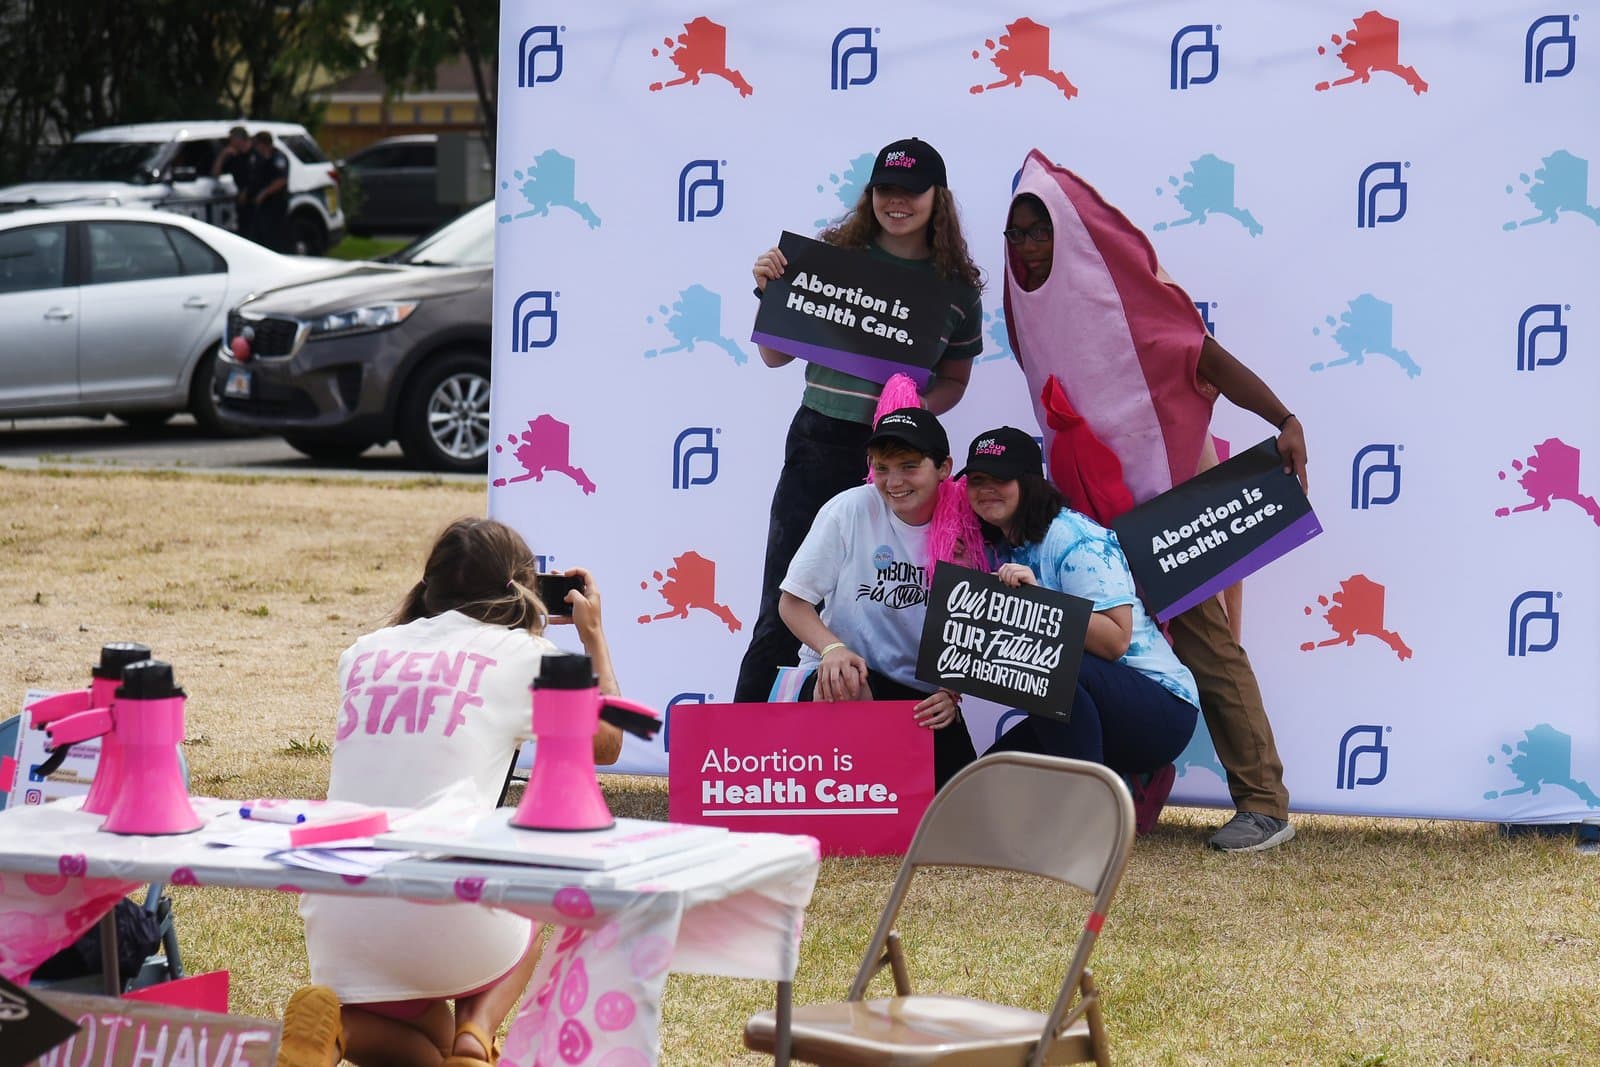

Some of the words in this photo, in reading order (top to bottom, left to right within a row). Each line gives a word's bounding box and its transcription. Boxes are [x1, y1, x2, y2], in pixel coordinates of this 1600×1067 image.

[786, 292, 856, 328] Health
[861, 315, 914, 345] Care.
[792, 271, 888, 313] Abortion
[892, 299, 910, 320] is
[1151, 499, 1243, 554] Abortion
[1242, 487, 1263, 505] is
[1158, 528, 1229, 574] Health
[1230, 502, 1283, 535] Care.
[869, 580, 885, 602] is
[947, 581, 988, 620] Our
[987, 591, 1064, 638] BODIES
[943, 620, 985, 652] OUR
[982, 629, 1064, 670] Futures
[347, 650, 497, 693] EVENT
[937, 645, 971, 675] Our
[971, 659, 1049, 698] ABORTIONS
[336, 686, 484, 740] STAFF
[700, 747, 823, 773] Abortion
[833, 747, 853, 772] is
[702, 778, 806, 804] Health
[815, 778, 898, 803] Care.
[134, 1022, 273, 1067] HAVE
